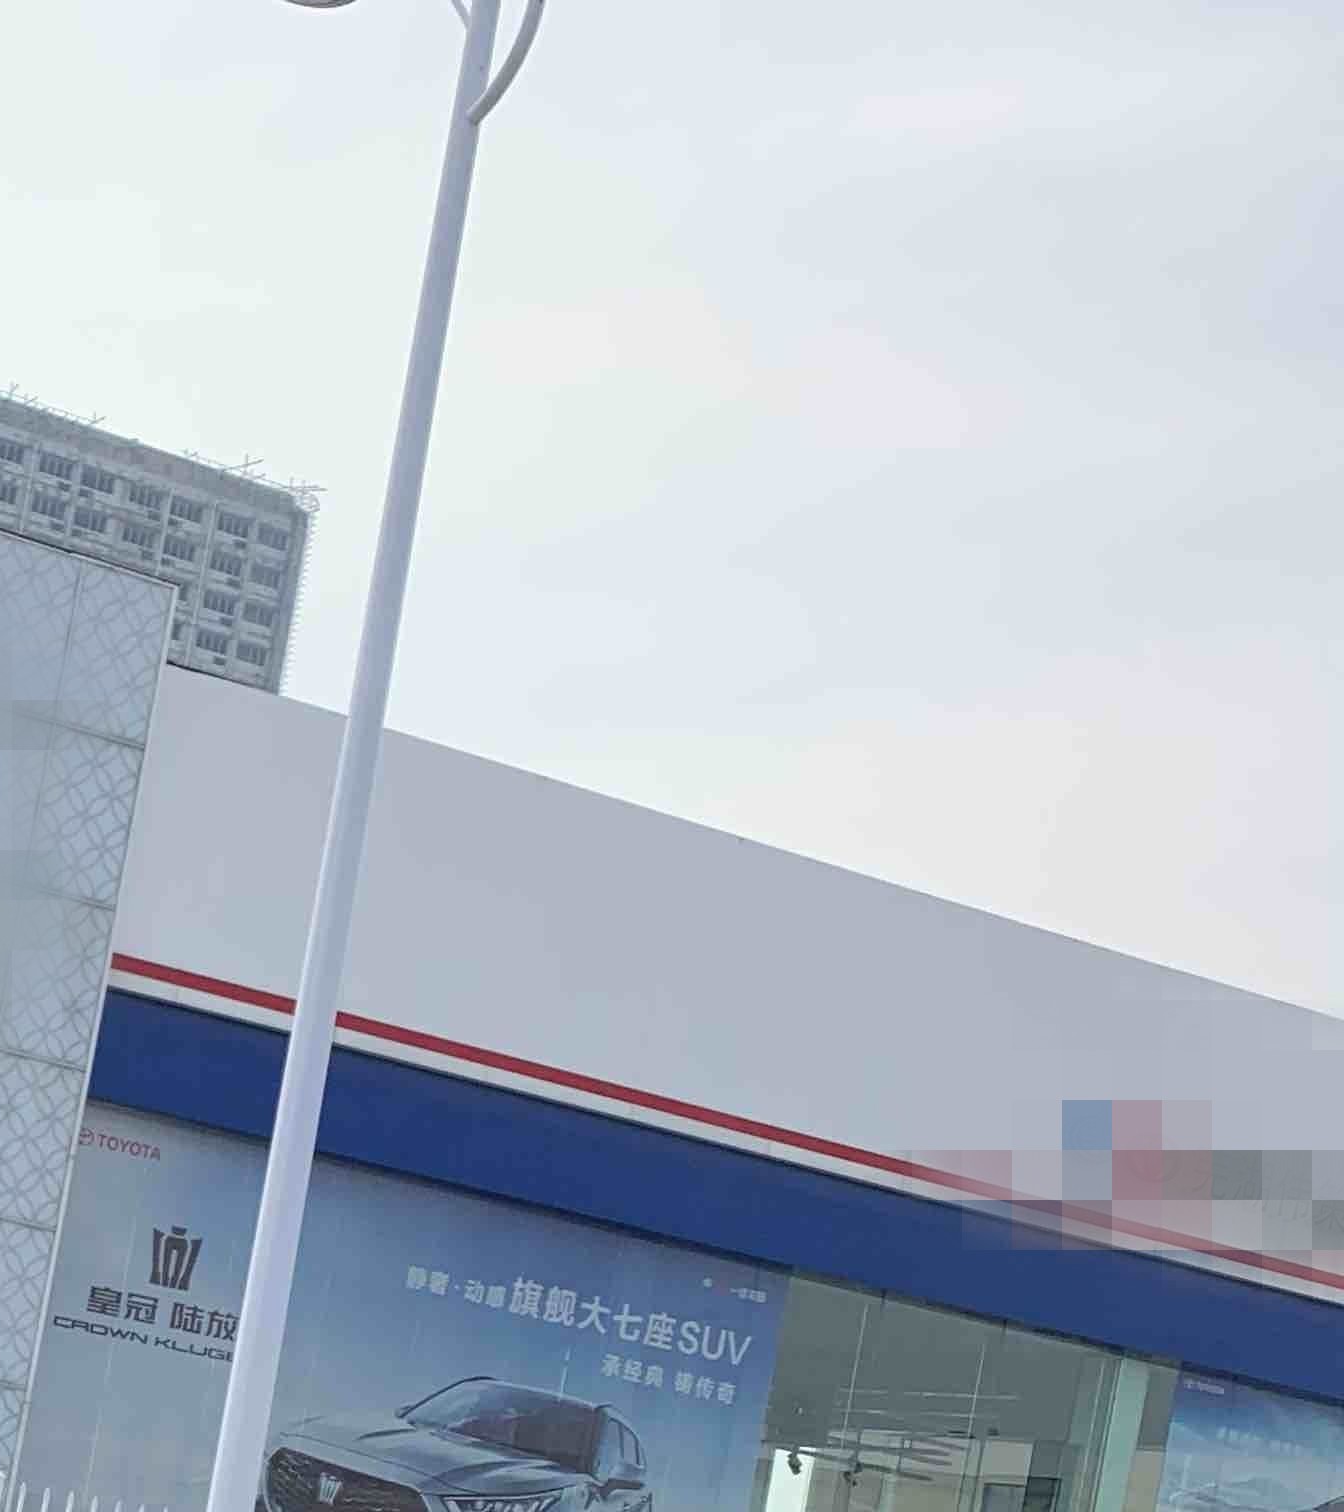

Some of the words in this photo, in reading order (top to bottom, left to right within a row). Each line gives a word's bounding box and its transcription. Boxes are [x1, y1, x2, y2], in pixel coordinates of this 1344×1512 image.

[98, 1133, 161, 1161] TOYOTA
[53, 1315, 149, 1345] CROWN
[86, 1285, 160, 1324] 皇冠
[169, 1302, 241, 1342] 陆放
[508, 1275, 753, 1367] 旗舰大七座SUV
